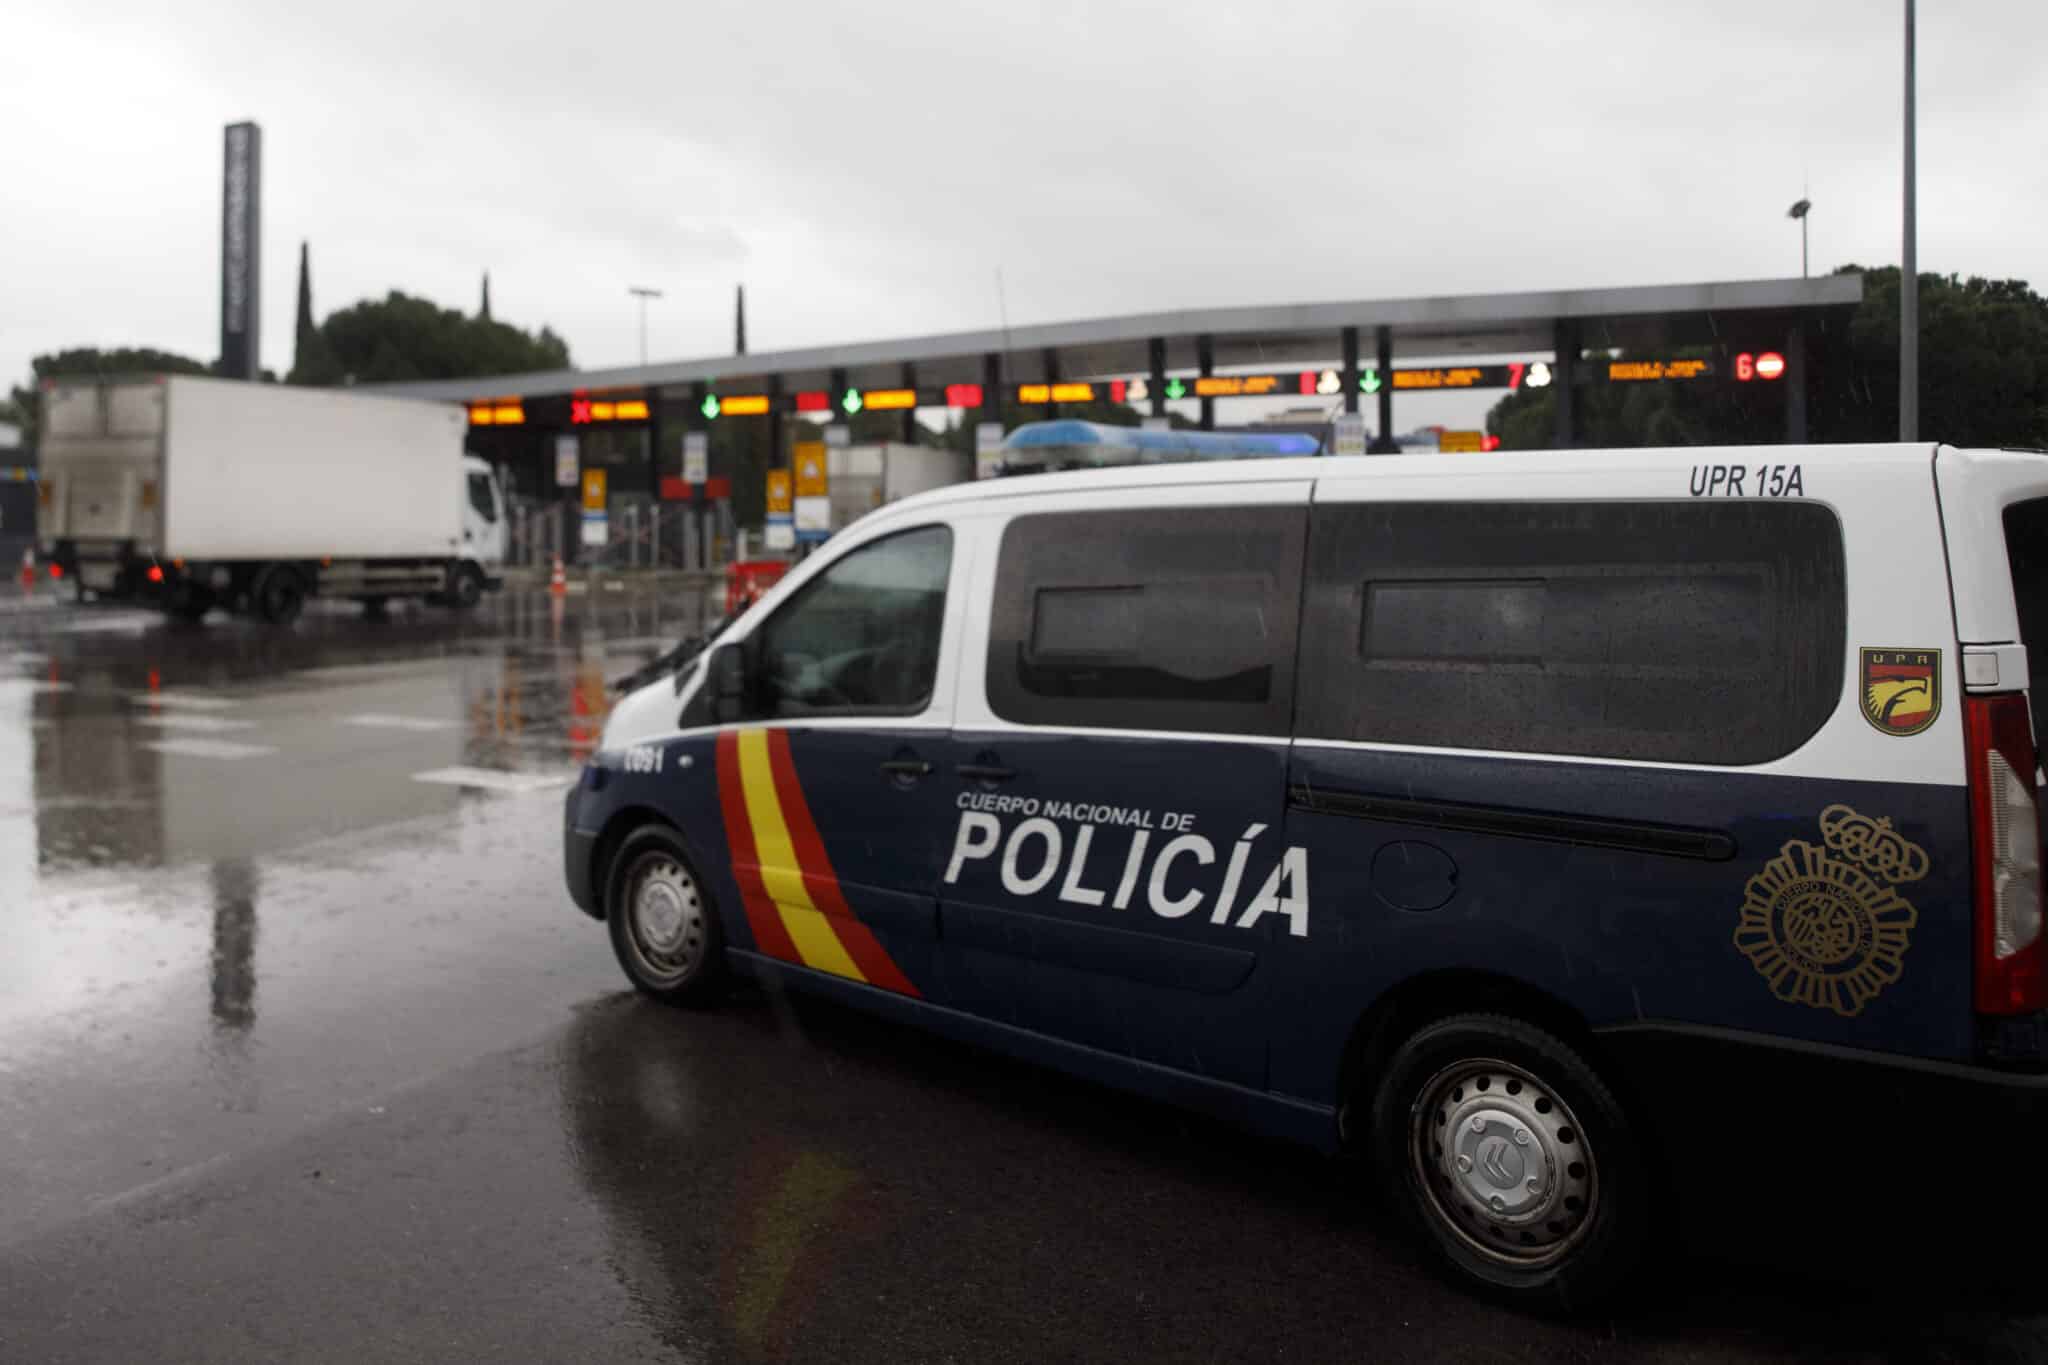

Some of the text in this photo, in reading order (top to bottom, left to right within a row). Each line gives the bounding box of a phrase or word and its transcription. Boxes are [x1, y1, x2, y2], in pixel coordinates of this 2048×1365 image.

[1507, 362, 1525, 390] 7
[1736, 352, 1753, 381] 6
[1690, 464, 1803, 496] UPR 15A
[956, 791, 1196, 832] CUERPO NACIONAL DE
[944, 810, 1308, 937] POLICÍA
